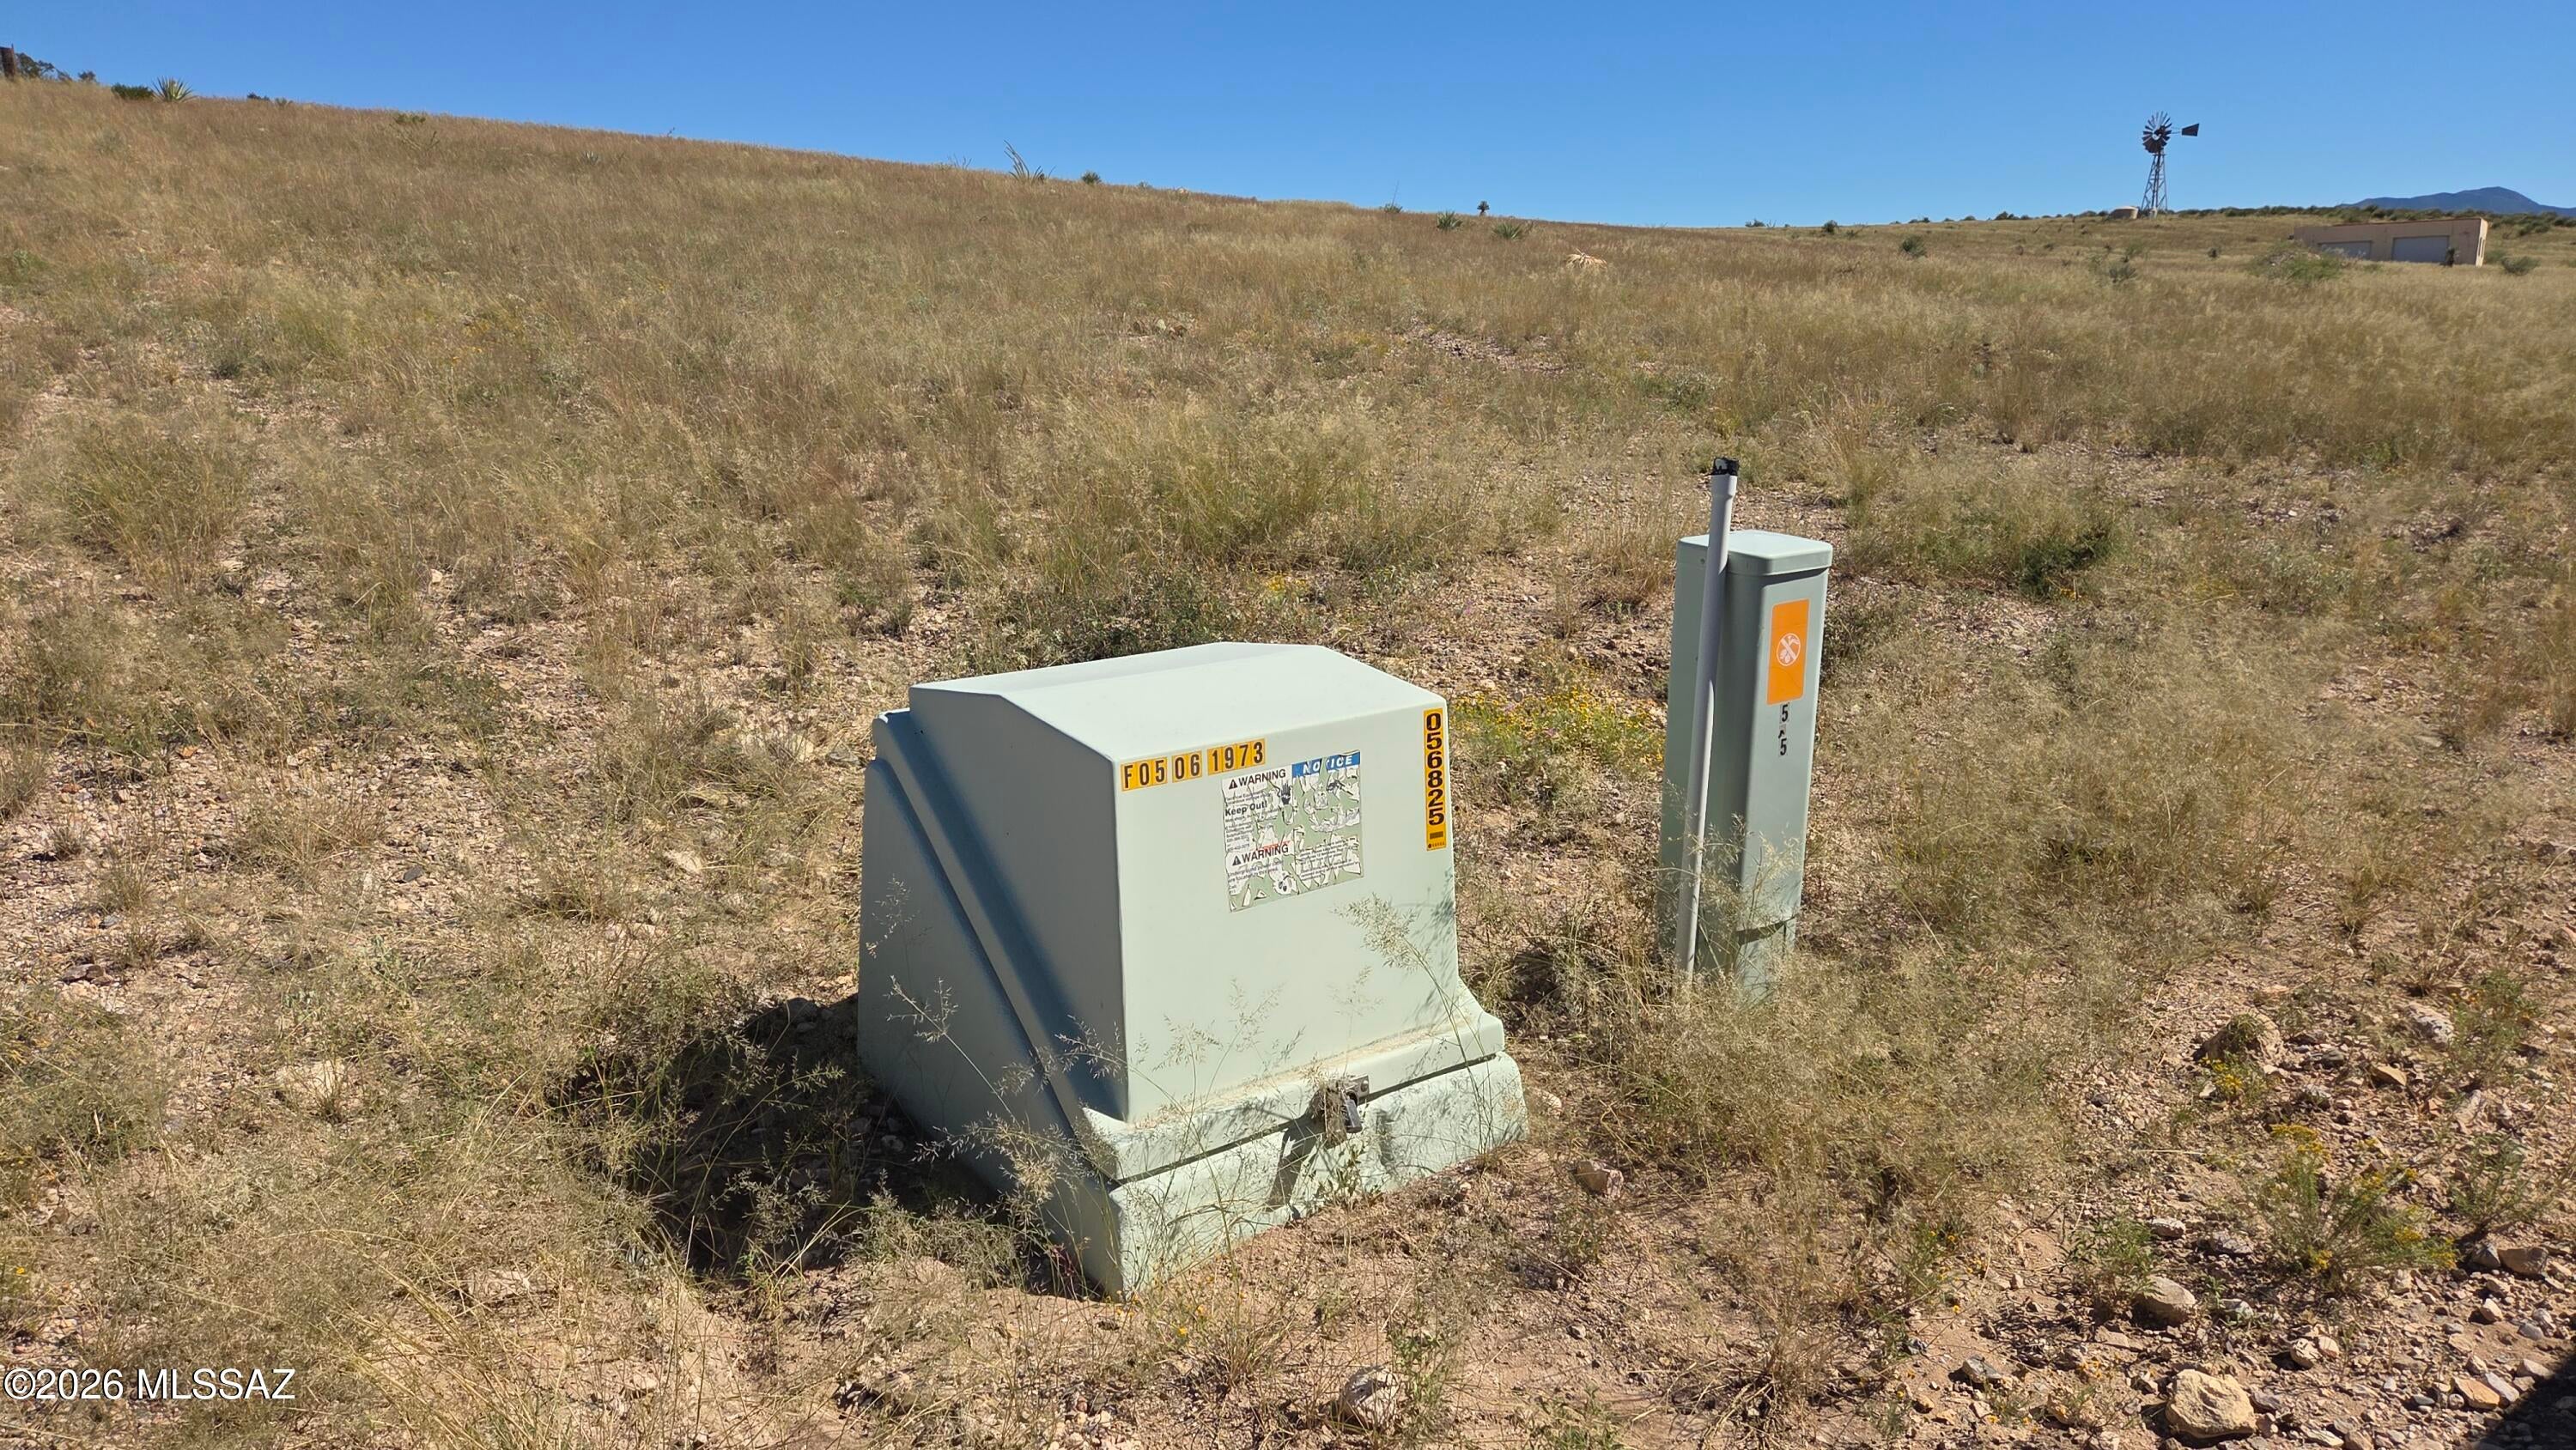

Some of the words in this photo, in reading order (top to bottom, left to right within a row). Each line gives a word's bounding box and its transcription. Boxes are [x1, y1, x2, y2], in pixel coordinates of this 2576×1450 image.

[1123, 759, 1166, 789] F05
[1174, 754, 1200, 780] 06
[1212, 741, 1264, 772] 1973
[1426, 713, 1445, 826] 056825
[1238, 768, 1286, 787] WARNING
[1224, 806, 1247, 816] Keep
[1242, 843, 1289, 864] WARNING
